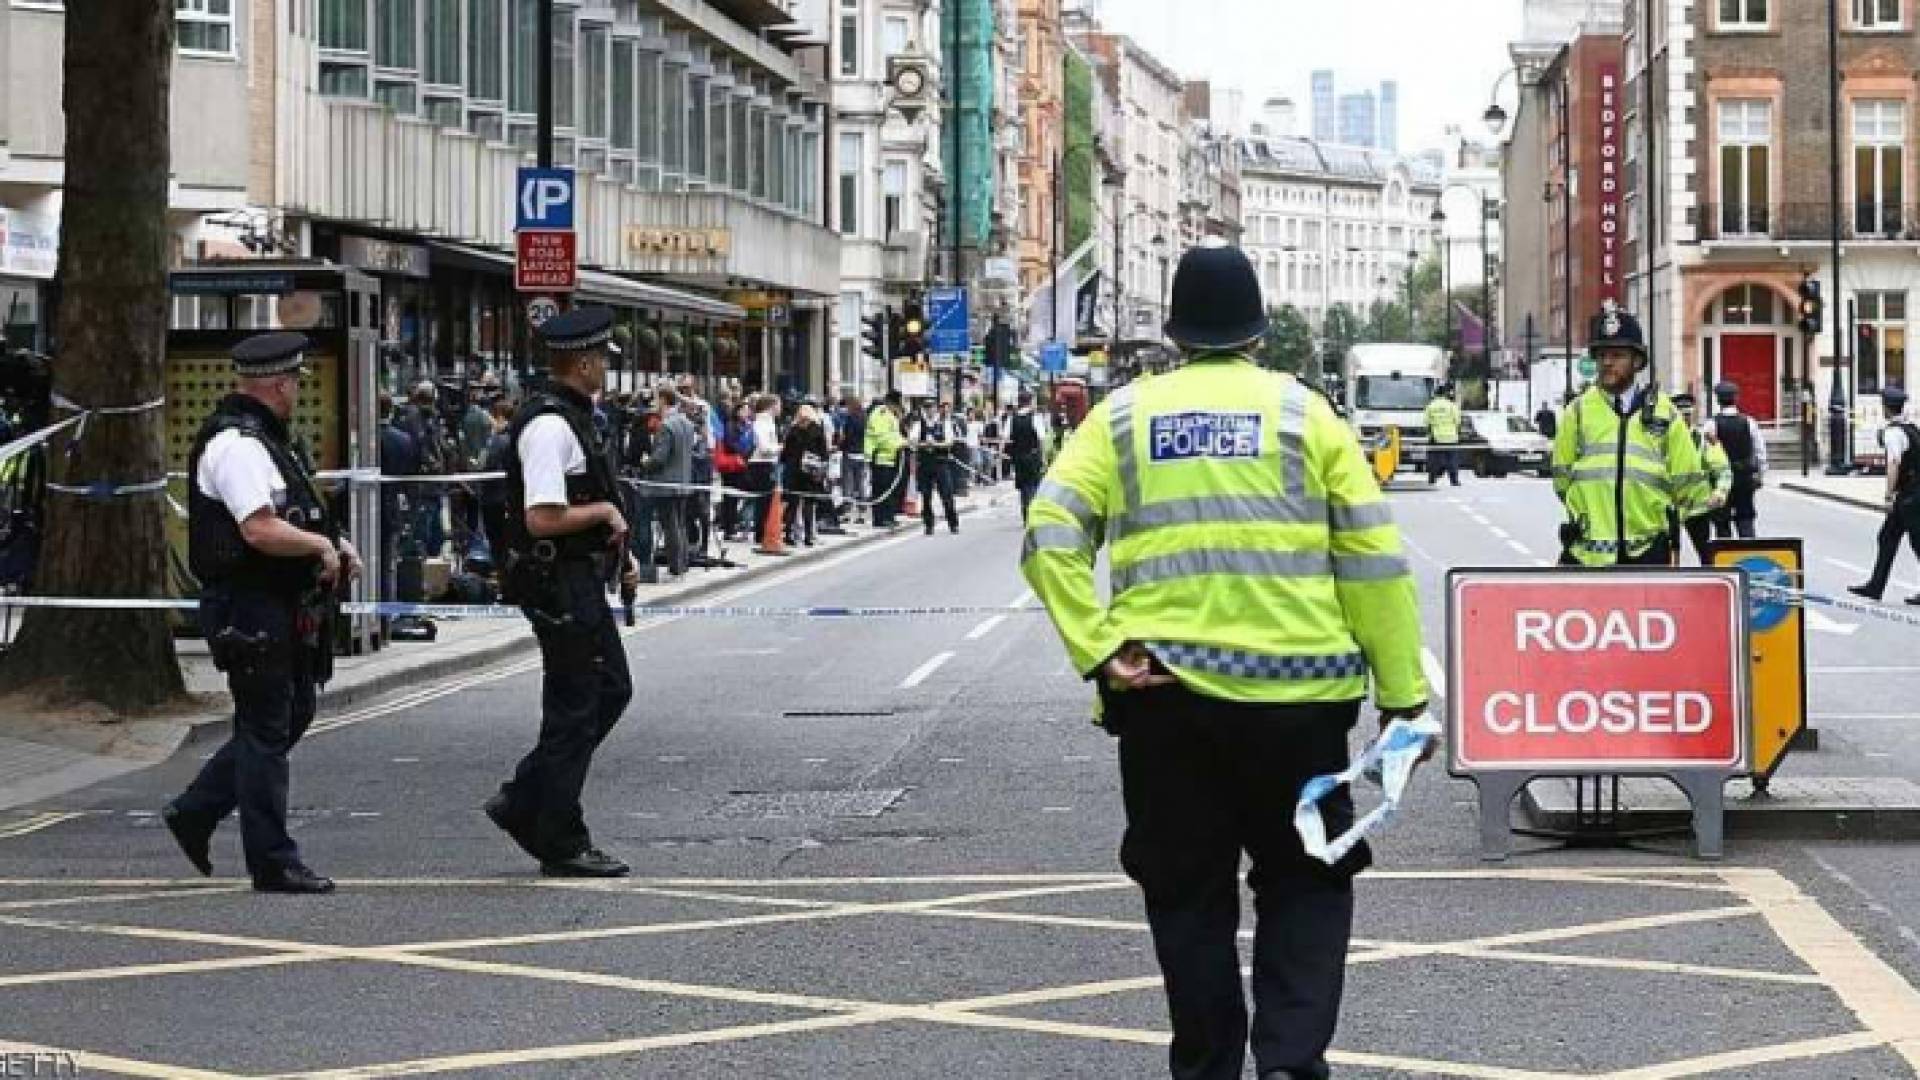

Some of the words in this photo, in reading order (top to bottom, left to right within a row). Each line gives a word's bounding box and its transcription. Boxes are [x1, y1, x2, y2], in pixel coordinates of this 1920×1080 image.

[1602, 74, 1616, 192] BEDFORD
[536, 179, 570, 220] P
[528, 247, 565, 259] ROAD
[531, 234, 562, 246] NEW
[1602, 203, 1616, 285] HOTEL
[522, 260, 571, 271] LAYOUT
[523, 272, 569, 284] AHEAD
[1155, 431, 1254, 457] POLICE
[1515, 609, 1677, 651] ROAD
[1484, 690, 1714, 734] CLOSED
